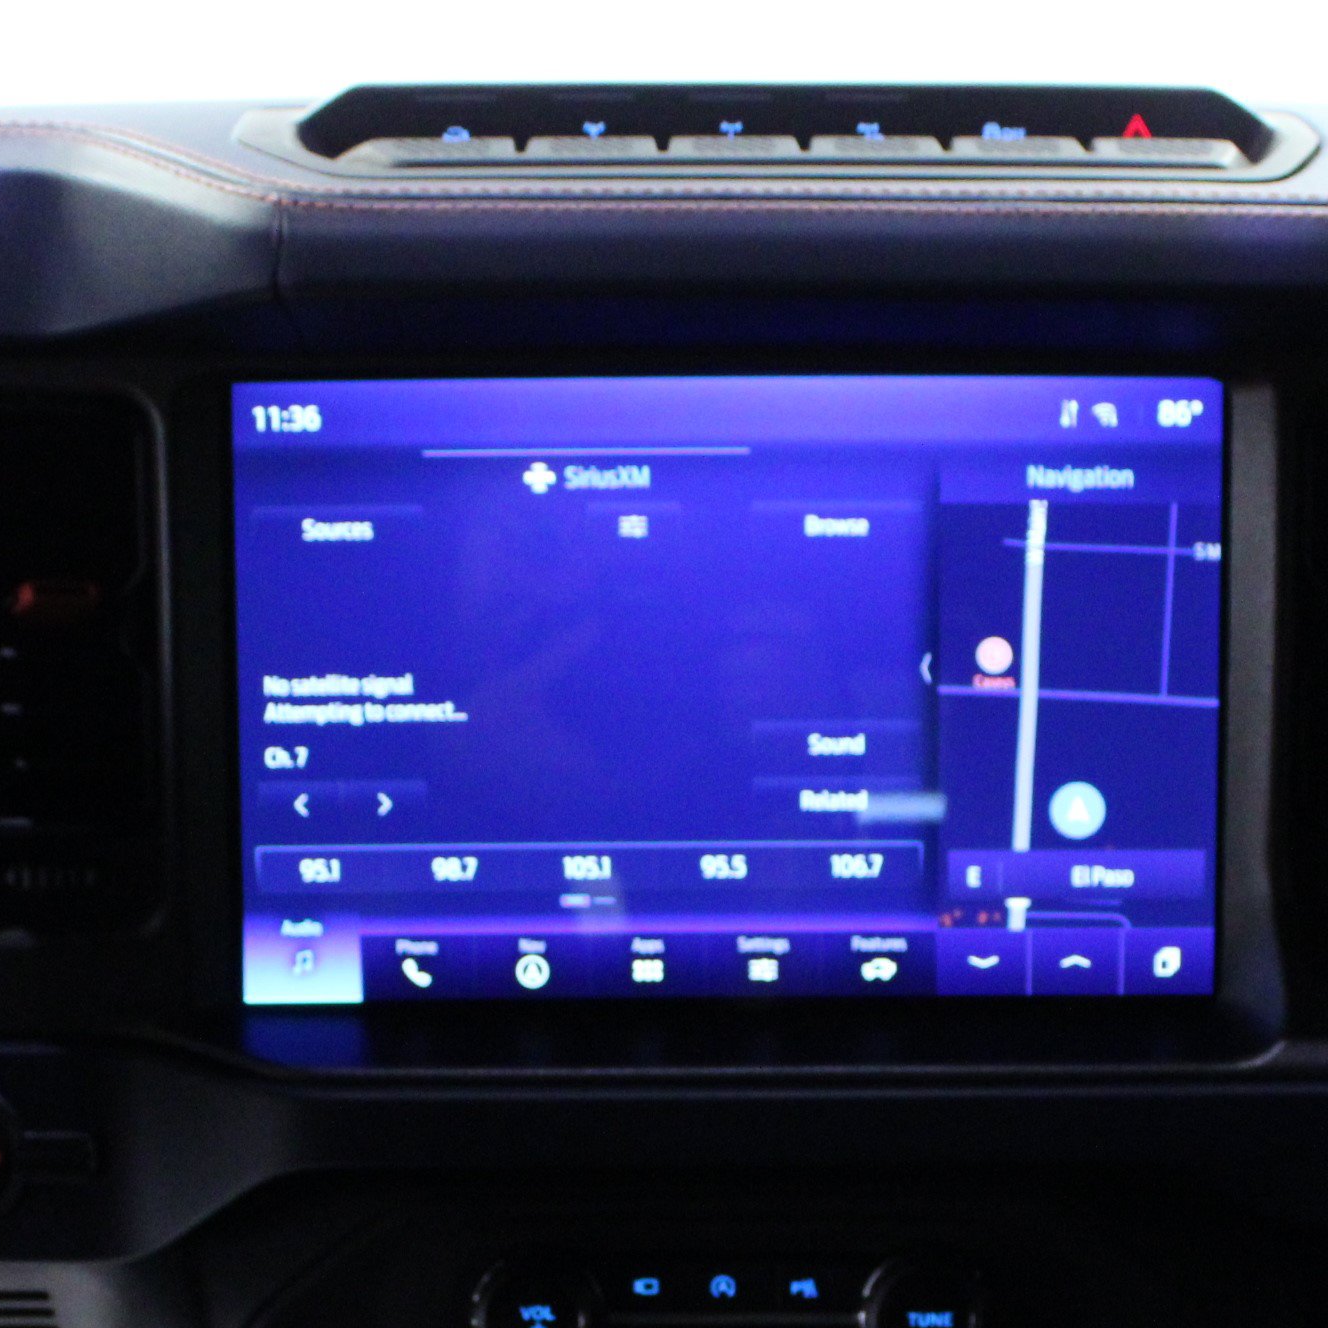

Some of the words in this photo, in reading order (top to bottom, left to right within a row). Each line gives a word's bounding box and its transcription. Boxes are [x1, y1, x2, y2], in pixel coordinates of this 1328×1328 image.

[252, 404, 322, 432] 11:36
[564, 465, 650, 490] SiriusXM
[1026, 465, 1134, 493] Navigation
[301, 517, 374, 542] Sources
[804, 514, 870, 537] Browse
[263, 674, 291, 697] No
[291, 673, 360, 697] satellite
[360, 672, 414, 700] signal
[263, 701, 364, 727] Attempting
[364, 701, 385, 723] to
[807, 733, 865, 756] Sound
[294, 746, 309, 768] 7
[799, 789, 869, 812] Related
[562, 855, 611, 880] 105.1
[1091, 865, 1135, 888] Paso
[520, 1304, 557, 1322] VOL
[907, 1310, 954, 1328] TUNE
